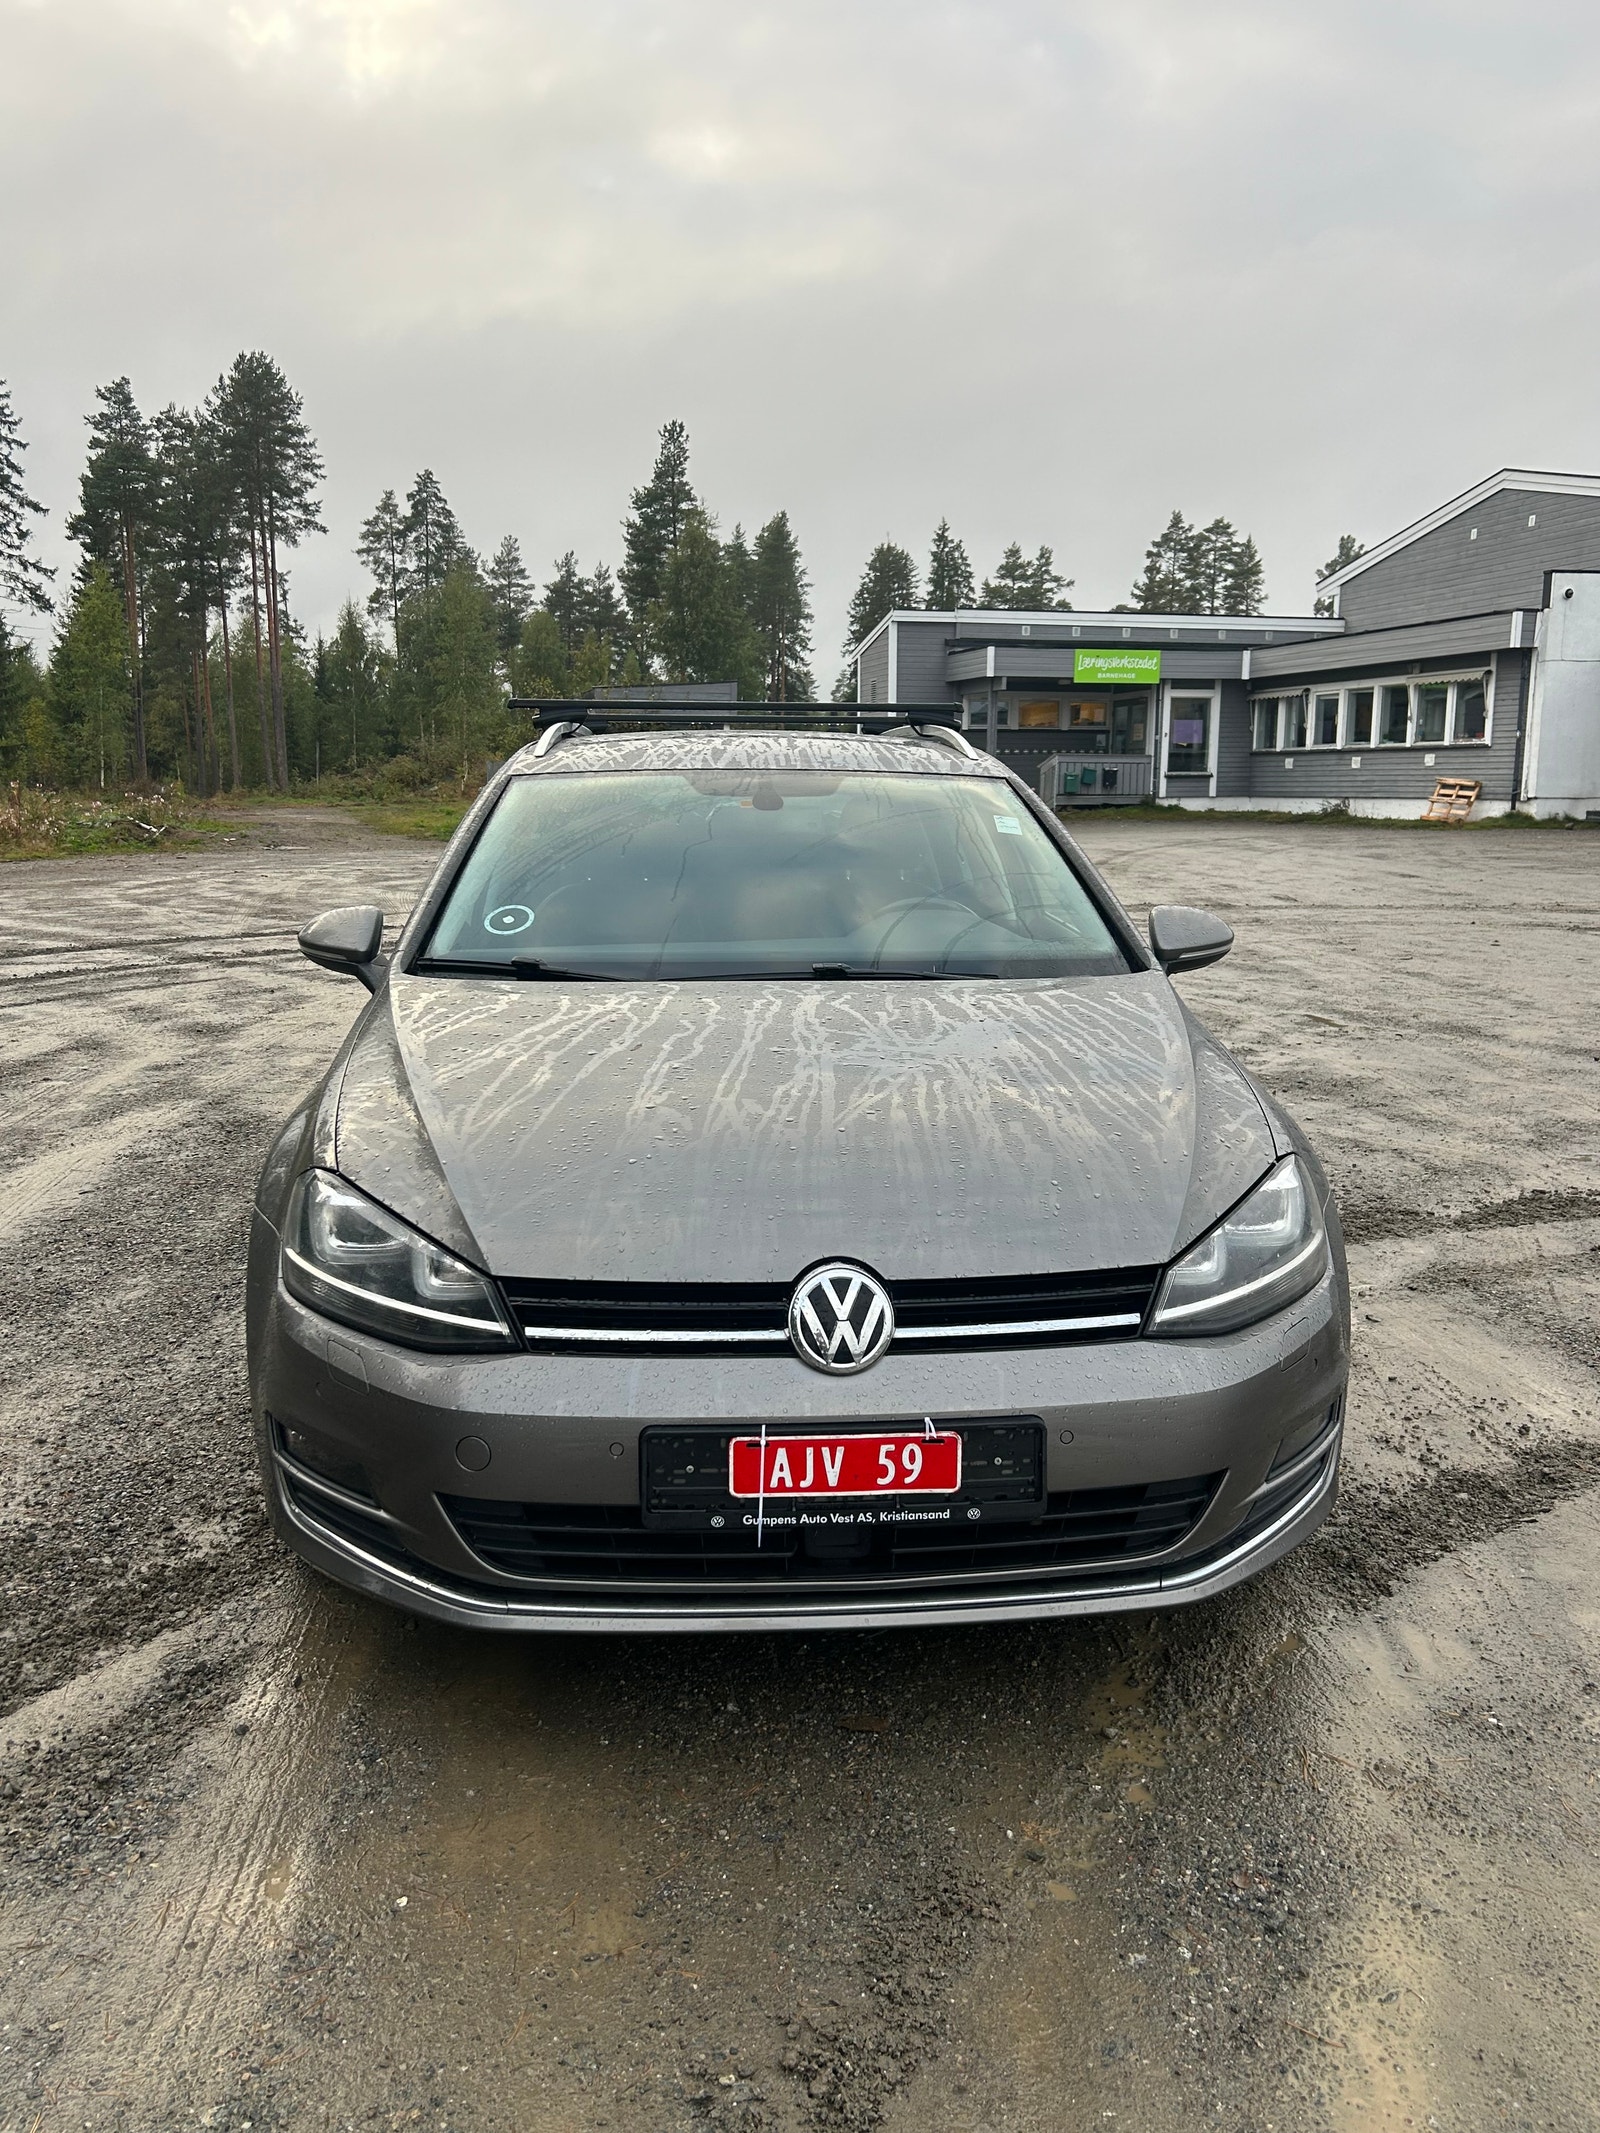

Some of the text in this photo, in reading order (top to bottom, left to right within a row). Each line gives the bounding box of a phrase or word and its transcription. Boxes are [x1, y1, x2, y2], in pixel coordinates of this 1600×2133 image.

[769, 1443, 923, 1488] AJV 59
[743, 1509, 950, 1527] Gumpens Auto Vest AS, Kristiansand
